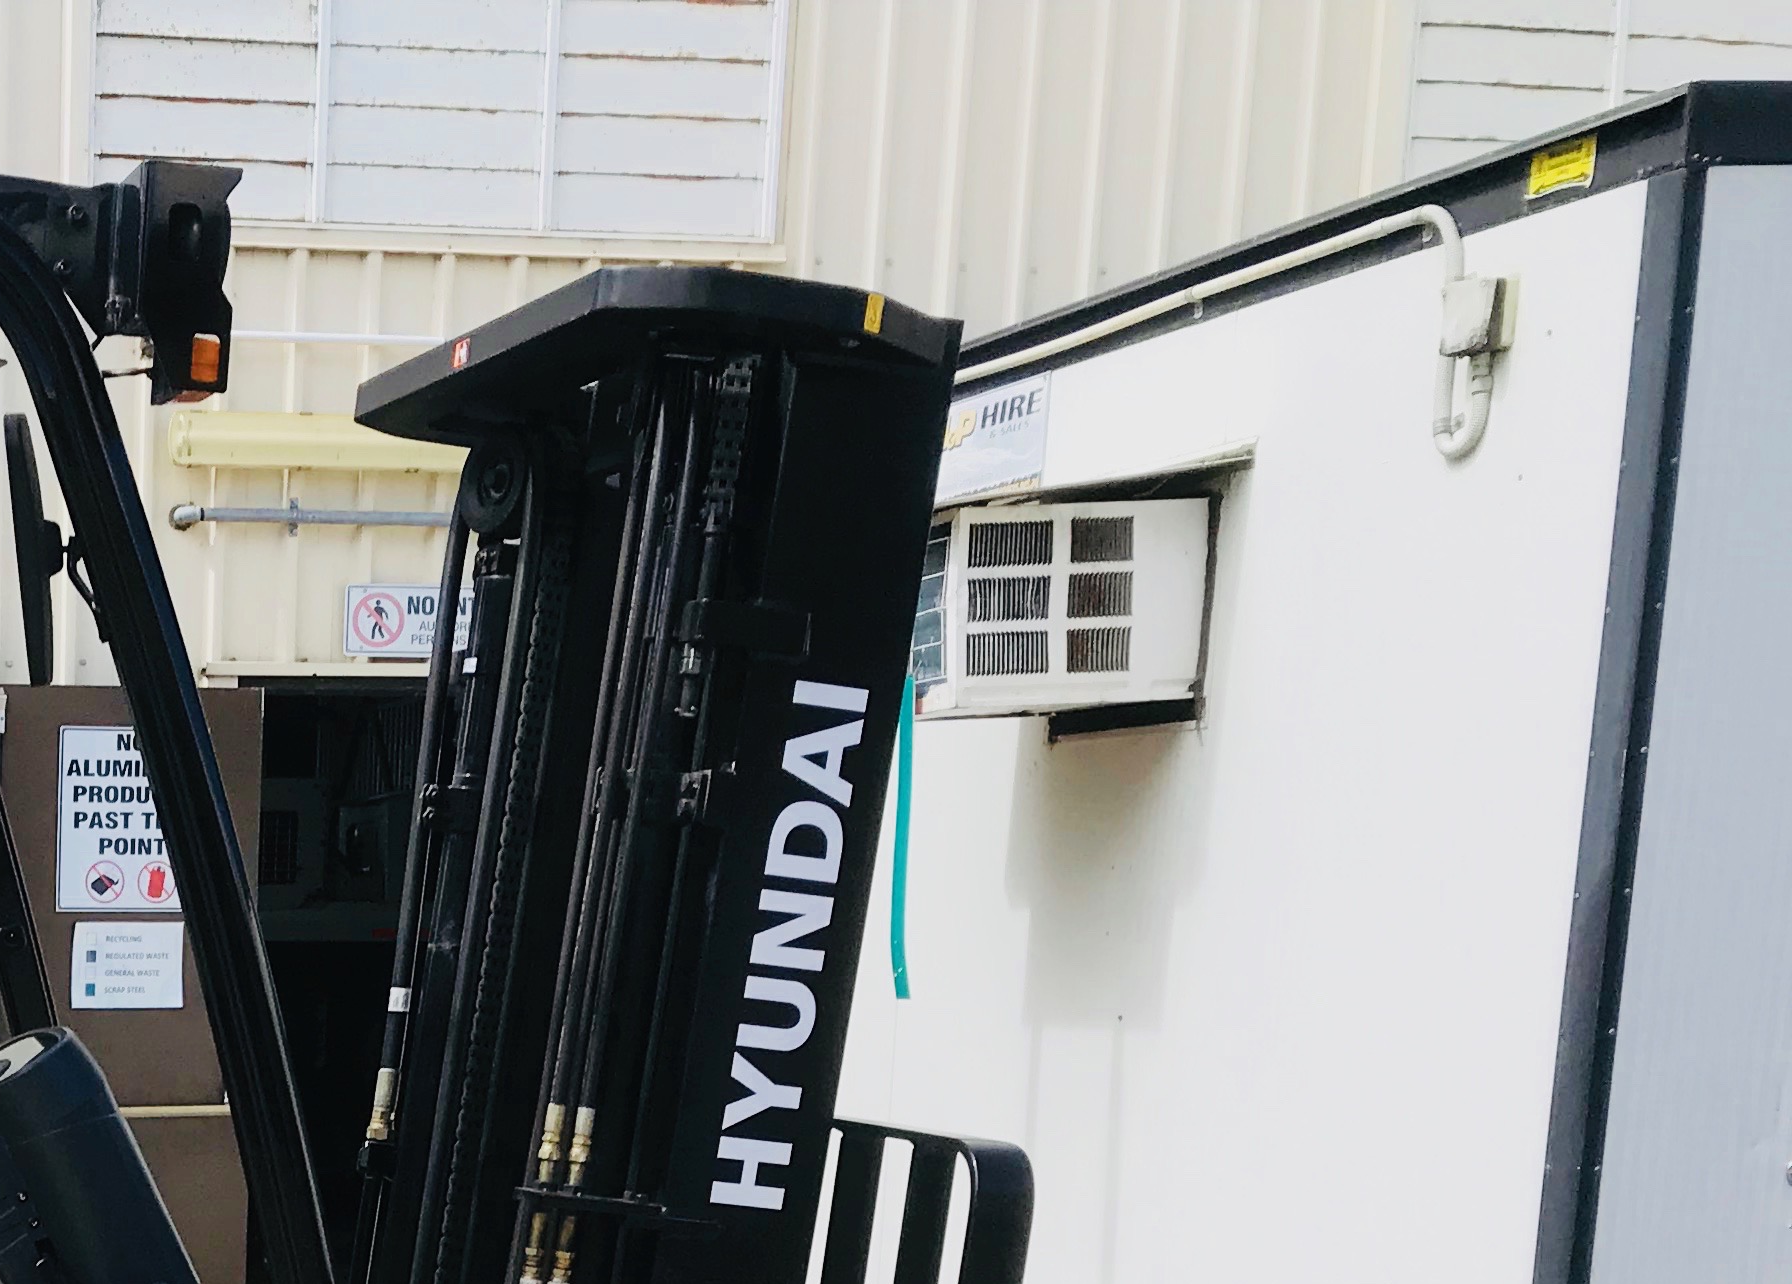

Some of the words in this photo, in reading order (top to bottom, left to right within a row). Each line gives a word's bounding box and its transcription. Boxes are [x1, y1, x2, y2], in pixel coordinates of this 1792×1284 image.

[981, 387, 1044, 429] HIRE
[407, 595, 435, 615] NO
[67, 759, 147, 777] ALUMI
[73, 785, 150, 803] PRODU
[74, 812, 133, 829] PAST
[99, 838, 165, 855] POINT
[710, 679, 869, 1211] HYUNDAI
[105, 952, 145, 960] REGULATED
[146, 952, 170, 960] WASTE
[104, 969, 135, 977] GENERAL
[137, 969, 160, 977] WASTE
[104, 986, 125, 994] SCRAP
[127, 986, 146, 994] STEEL
